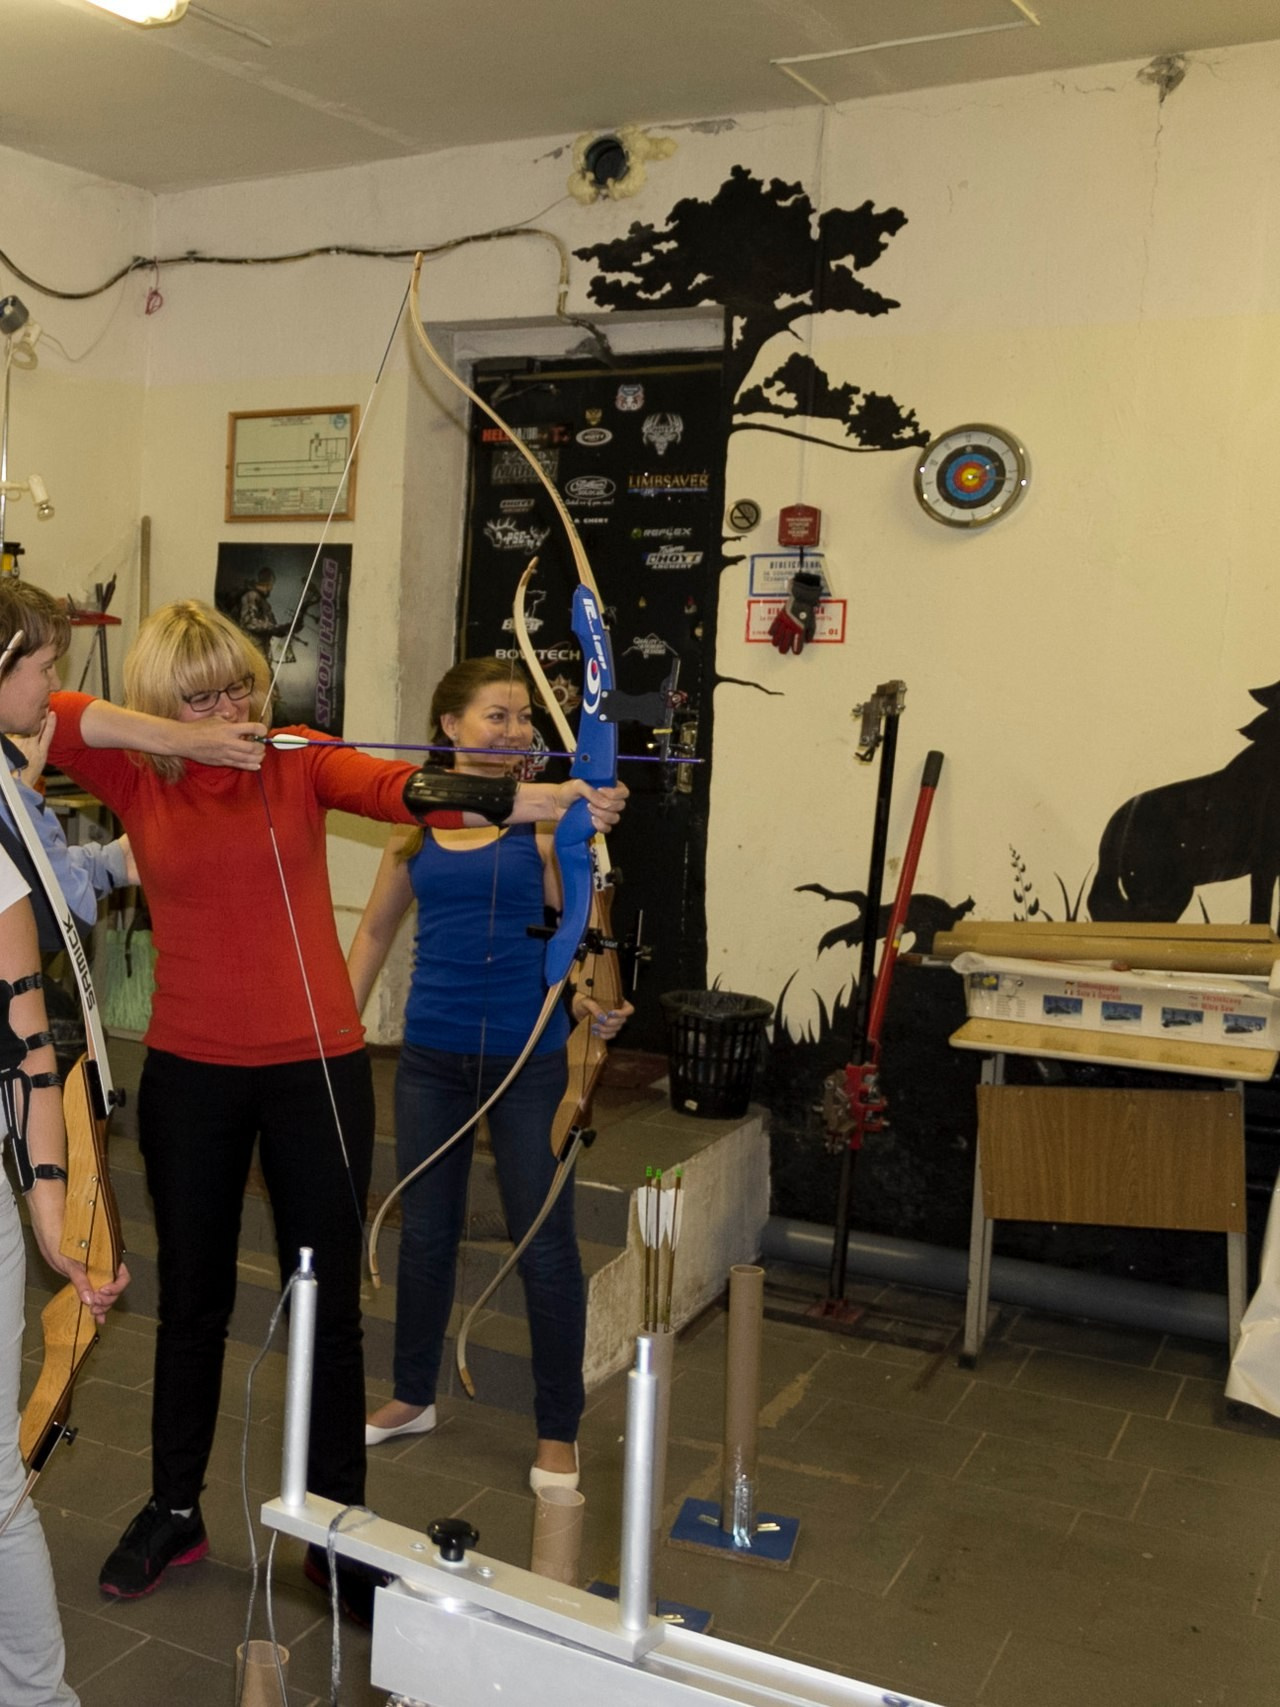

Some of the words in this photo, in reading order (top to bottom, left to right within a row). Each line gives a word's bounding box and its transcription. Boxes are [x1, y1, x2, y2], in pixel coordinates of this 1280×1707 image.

[628, 474, 710, 488] LIMBSAVER
[643, 527, 693, 537] REFLEX
[319, 557, 338, 643] HOGG
[501, 618, 544, 631] Bar
[315, 645, 333, 727] SPOT
[62, 913, 96, 1011] SAMICK
